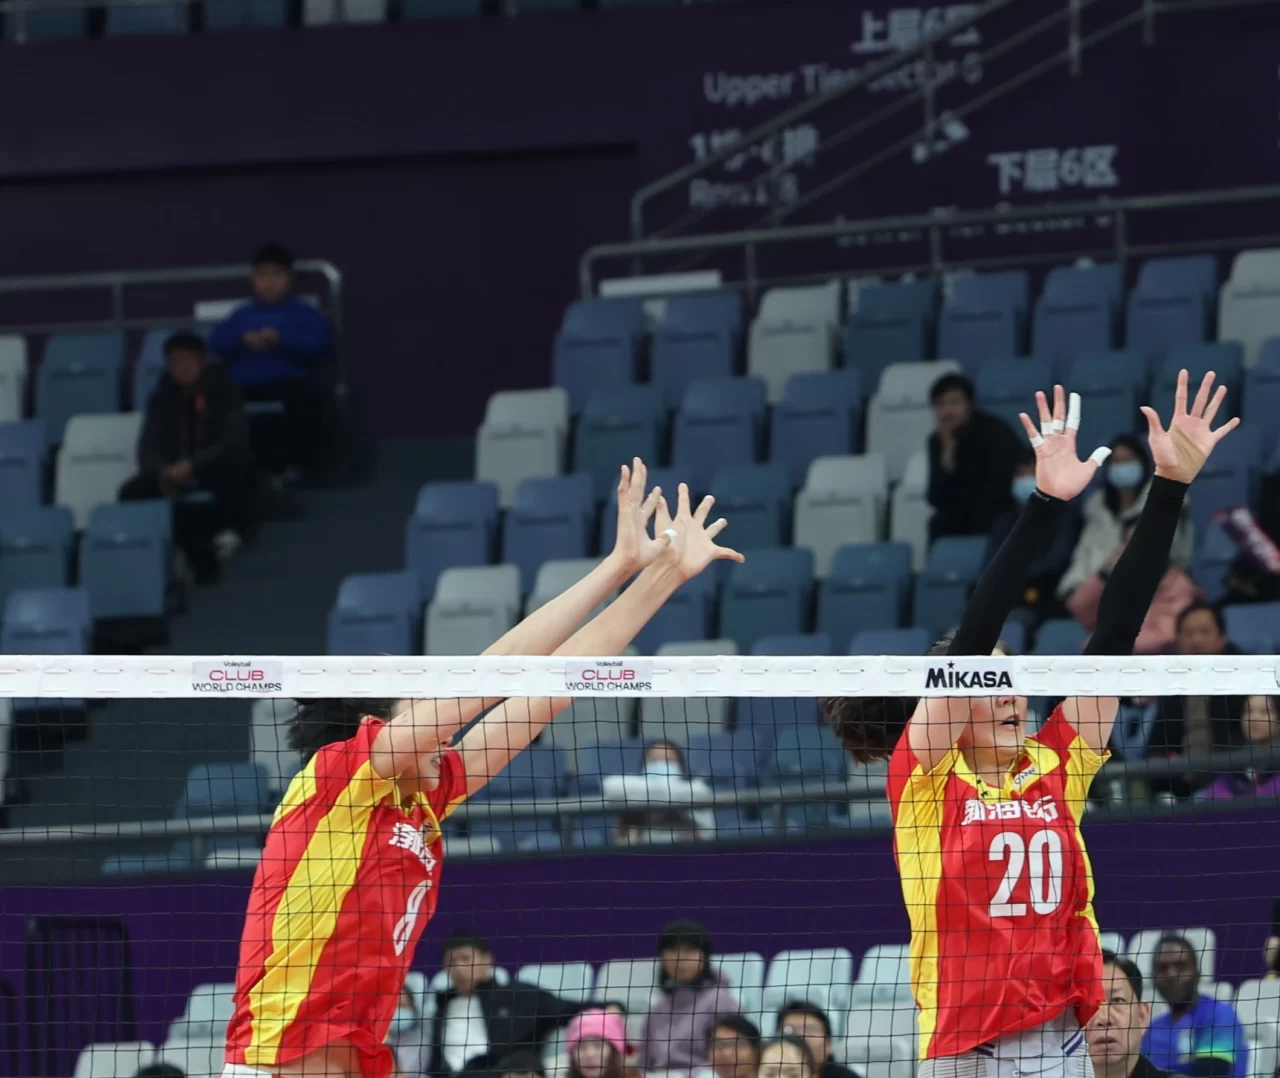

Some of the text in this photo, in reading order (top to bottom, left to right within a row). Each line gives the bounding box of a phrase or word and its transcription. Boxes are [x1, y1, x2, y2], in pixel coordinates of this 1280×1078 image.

[703, 71, 794, 109] Upper
[988, 144, 1118, 196] 下层6区
[209, 669, 264, 681] CLUB
[581, 669, 635, 681] CLUB
[925, 663, 1013, 689] MIKASA
[192, 682, 282, 692] WORLD CHAMPS
[565, 682, 652, 691] WORLD CHAMPS
[988, 830, 1062, 917] 20
